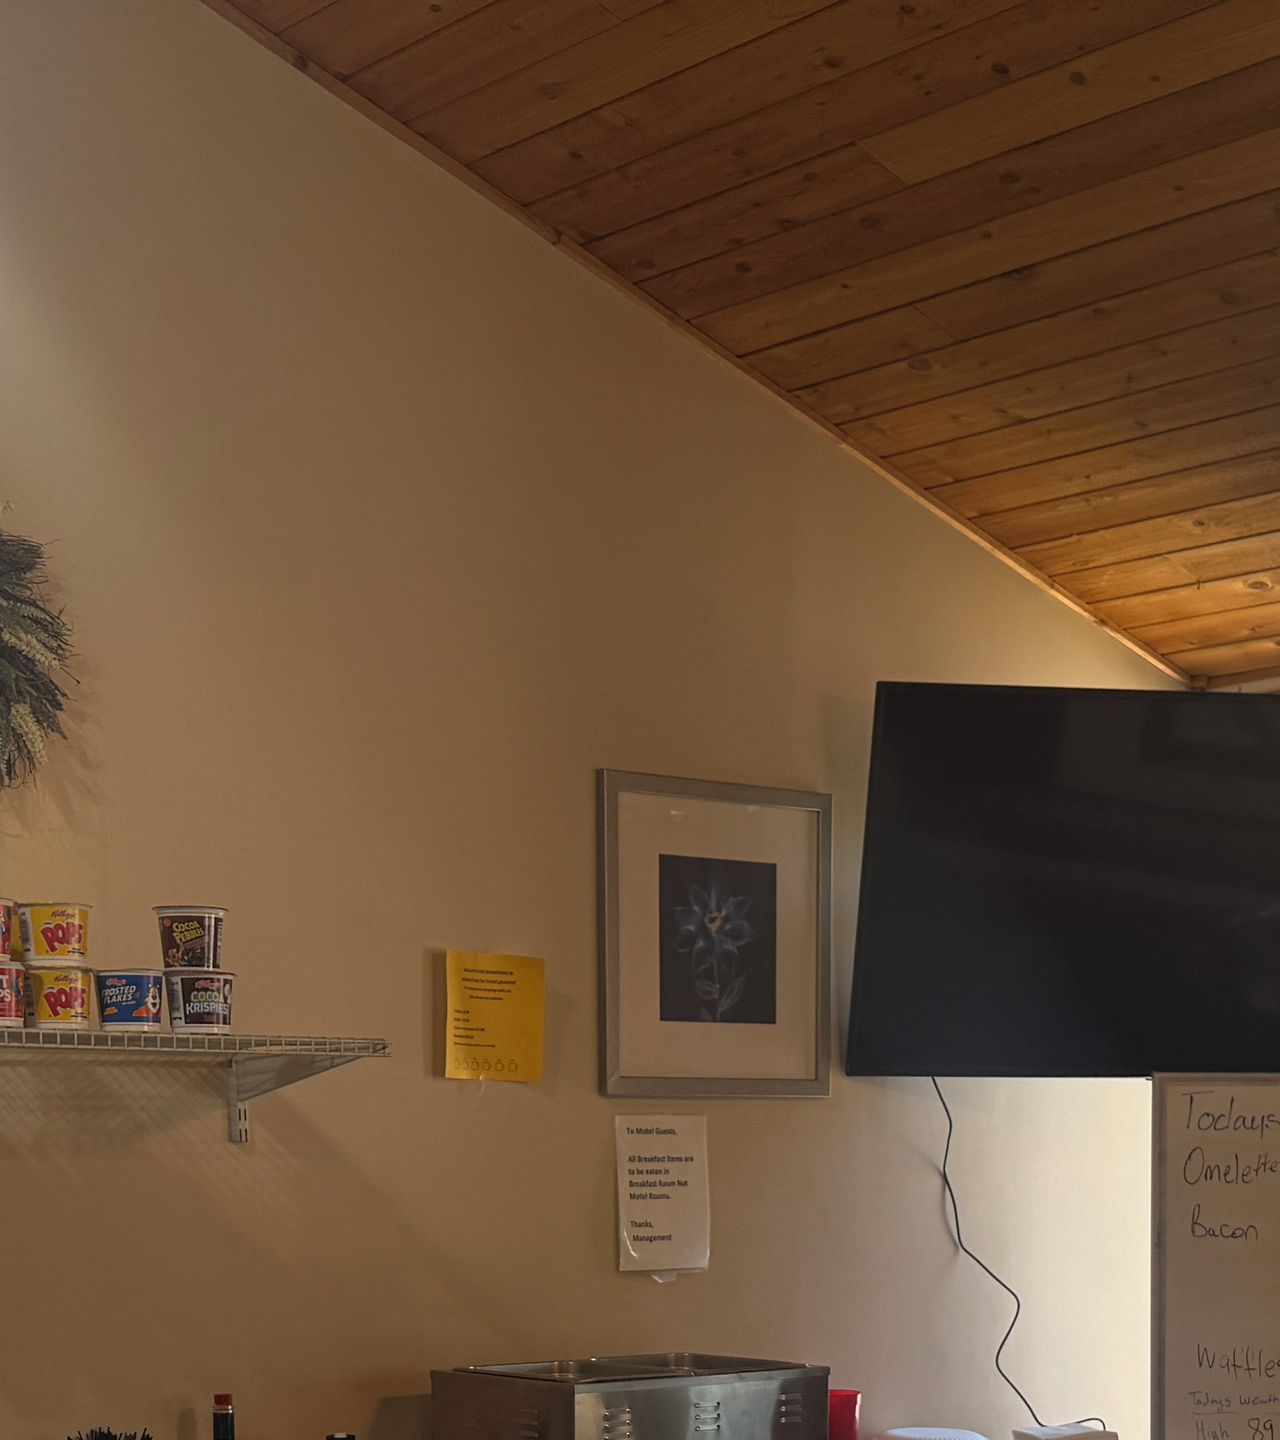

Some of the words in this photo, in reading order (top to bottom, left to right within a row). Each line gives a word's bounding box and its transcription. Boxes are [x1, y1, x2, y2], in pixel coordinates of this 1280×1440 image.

[186, 1002, 229, 1015] KRISPIES
[637, 1155, 666, 1163] Breakfast
[1191, 1203, 1259, 1240] Bacon
[632, 1234, 672, 1243] Management
